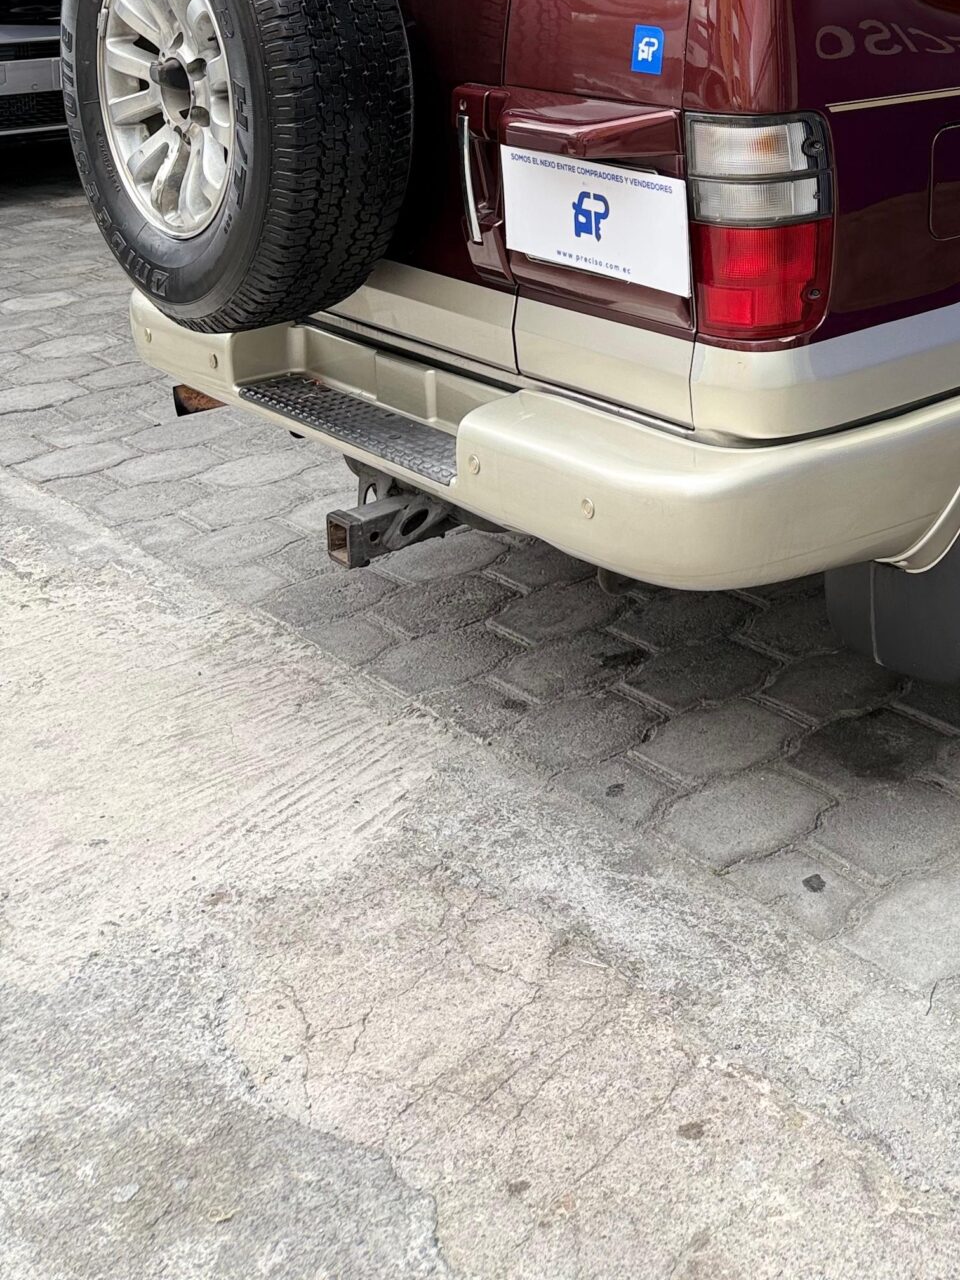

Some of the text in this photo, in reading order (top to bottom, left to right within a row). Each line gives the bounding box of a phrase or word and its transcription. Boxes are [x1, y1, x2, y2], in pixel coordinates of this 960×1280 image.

[511, 152, 531, 164] SOMOS
[532, 157, 540, 166] EL
[540, 159, 556, 170] NEXO
[557, 162, 577, 174] ENTRE
[577, 166, 624, 184] COMPRADORES
[629, 178, 673, 194] VENDEDORES
